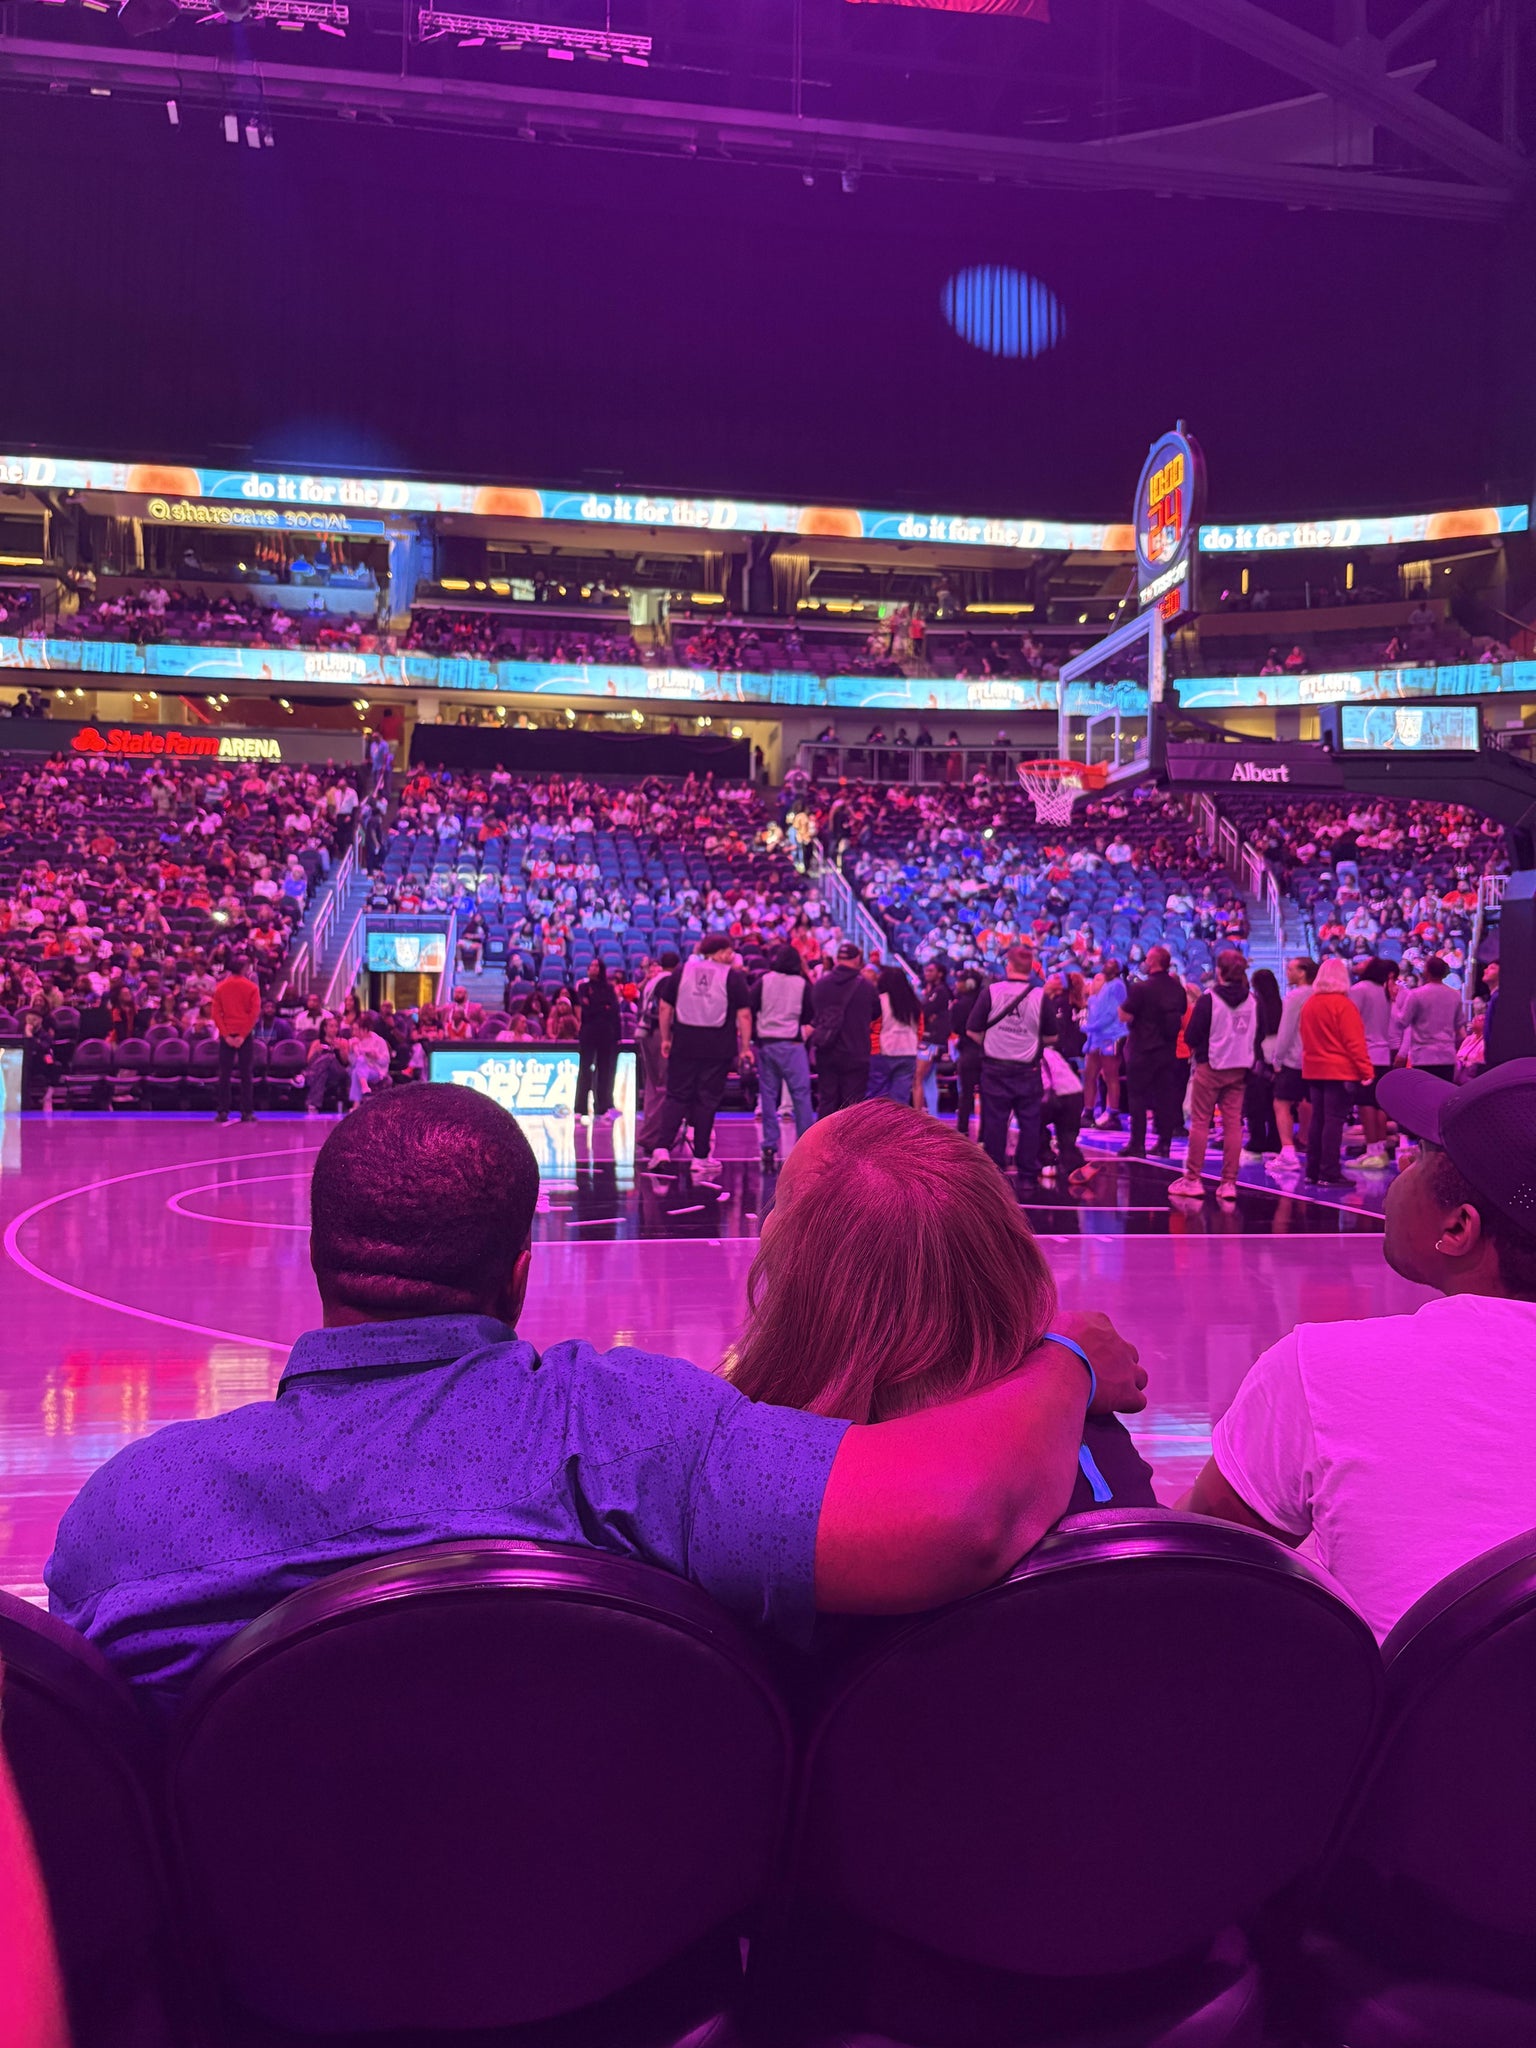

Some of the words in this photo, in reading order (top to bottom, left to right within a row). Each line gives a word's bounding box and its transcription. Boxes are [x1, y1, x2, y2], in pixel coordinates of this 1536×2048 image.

[27, 458, 56, 486] D
[242, 473, 275, 498] do
[277, 477, 297, 499] it
[300, 478, 336, 502] for
[339, 481, 378, 506] the
[377, 481, 410, 509] D
[284, 509, 349, 530] SOCIAL
[581, 494, 612, 519] do
[614, 497, 632, 521] it
[635, 498, 669, 523] for
[672, 501, 709, 526] the
[707, 502, 737, 529] D
[1148, 488, 1181, 561] 24
[898, 517, 928, 538] do
[929, 518, 946, 540] it
[949, 518, 980, 542] for
[983, 521, 1018, 546] the
[1016, 522, 1045, 548] D
[1204, 527, 1234, 549] do
[1235, 527, 1253, 548] it
[1256, 526, 1289, 547] for
[1293, 524, 1331, 546] the
[1328, 521, 1361, 547] D
[107, 729, 165, 753] State
[165, 732, 220, 756] Farm
[218, 738, 282, 758] ARENA
[1231, 761, 1290, 782] Albert
[480, 1059, 508, 1076] do
[509, 1059, 525, 1075] it
[526, 1059, 555, 1075] for
[557, 1059, 579, 1075] th
[452, 1071, 579, 1109] DREA
